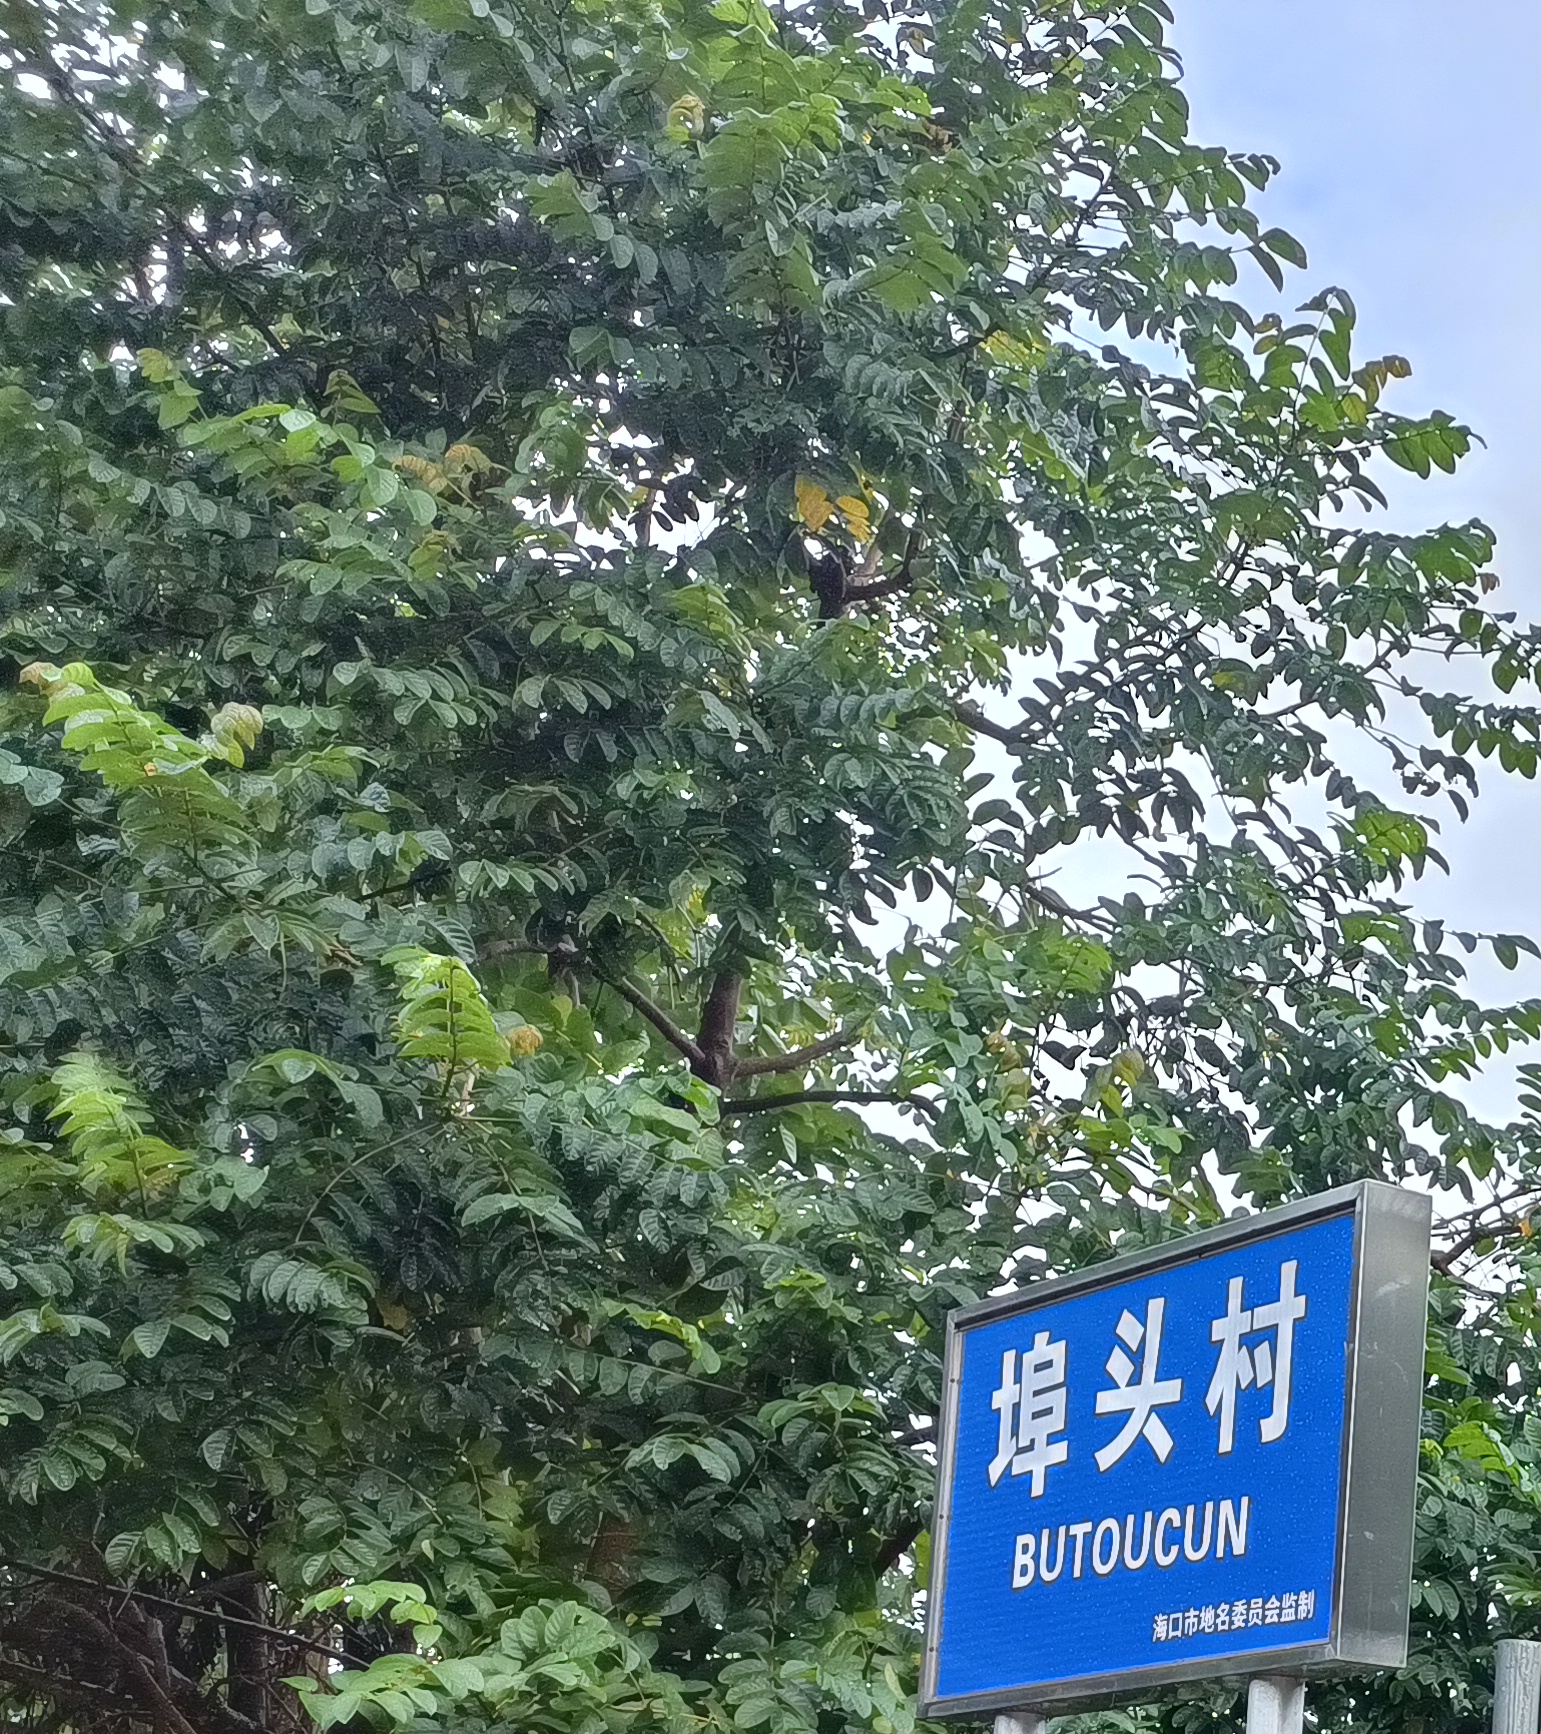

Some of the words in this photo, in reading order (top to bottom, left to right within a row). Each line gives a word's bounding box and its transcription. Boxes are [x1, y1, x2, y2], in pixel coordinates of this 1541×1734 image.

[988, 1259, 1306, 1498] 埠头村
[1011, 1496, 1251, 1590] BUTOUCUN
[1152, 1589, 1315, 1643] 海口市地名委员会监制
